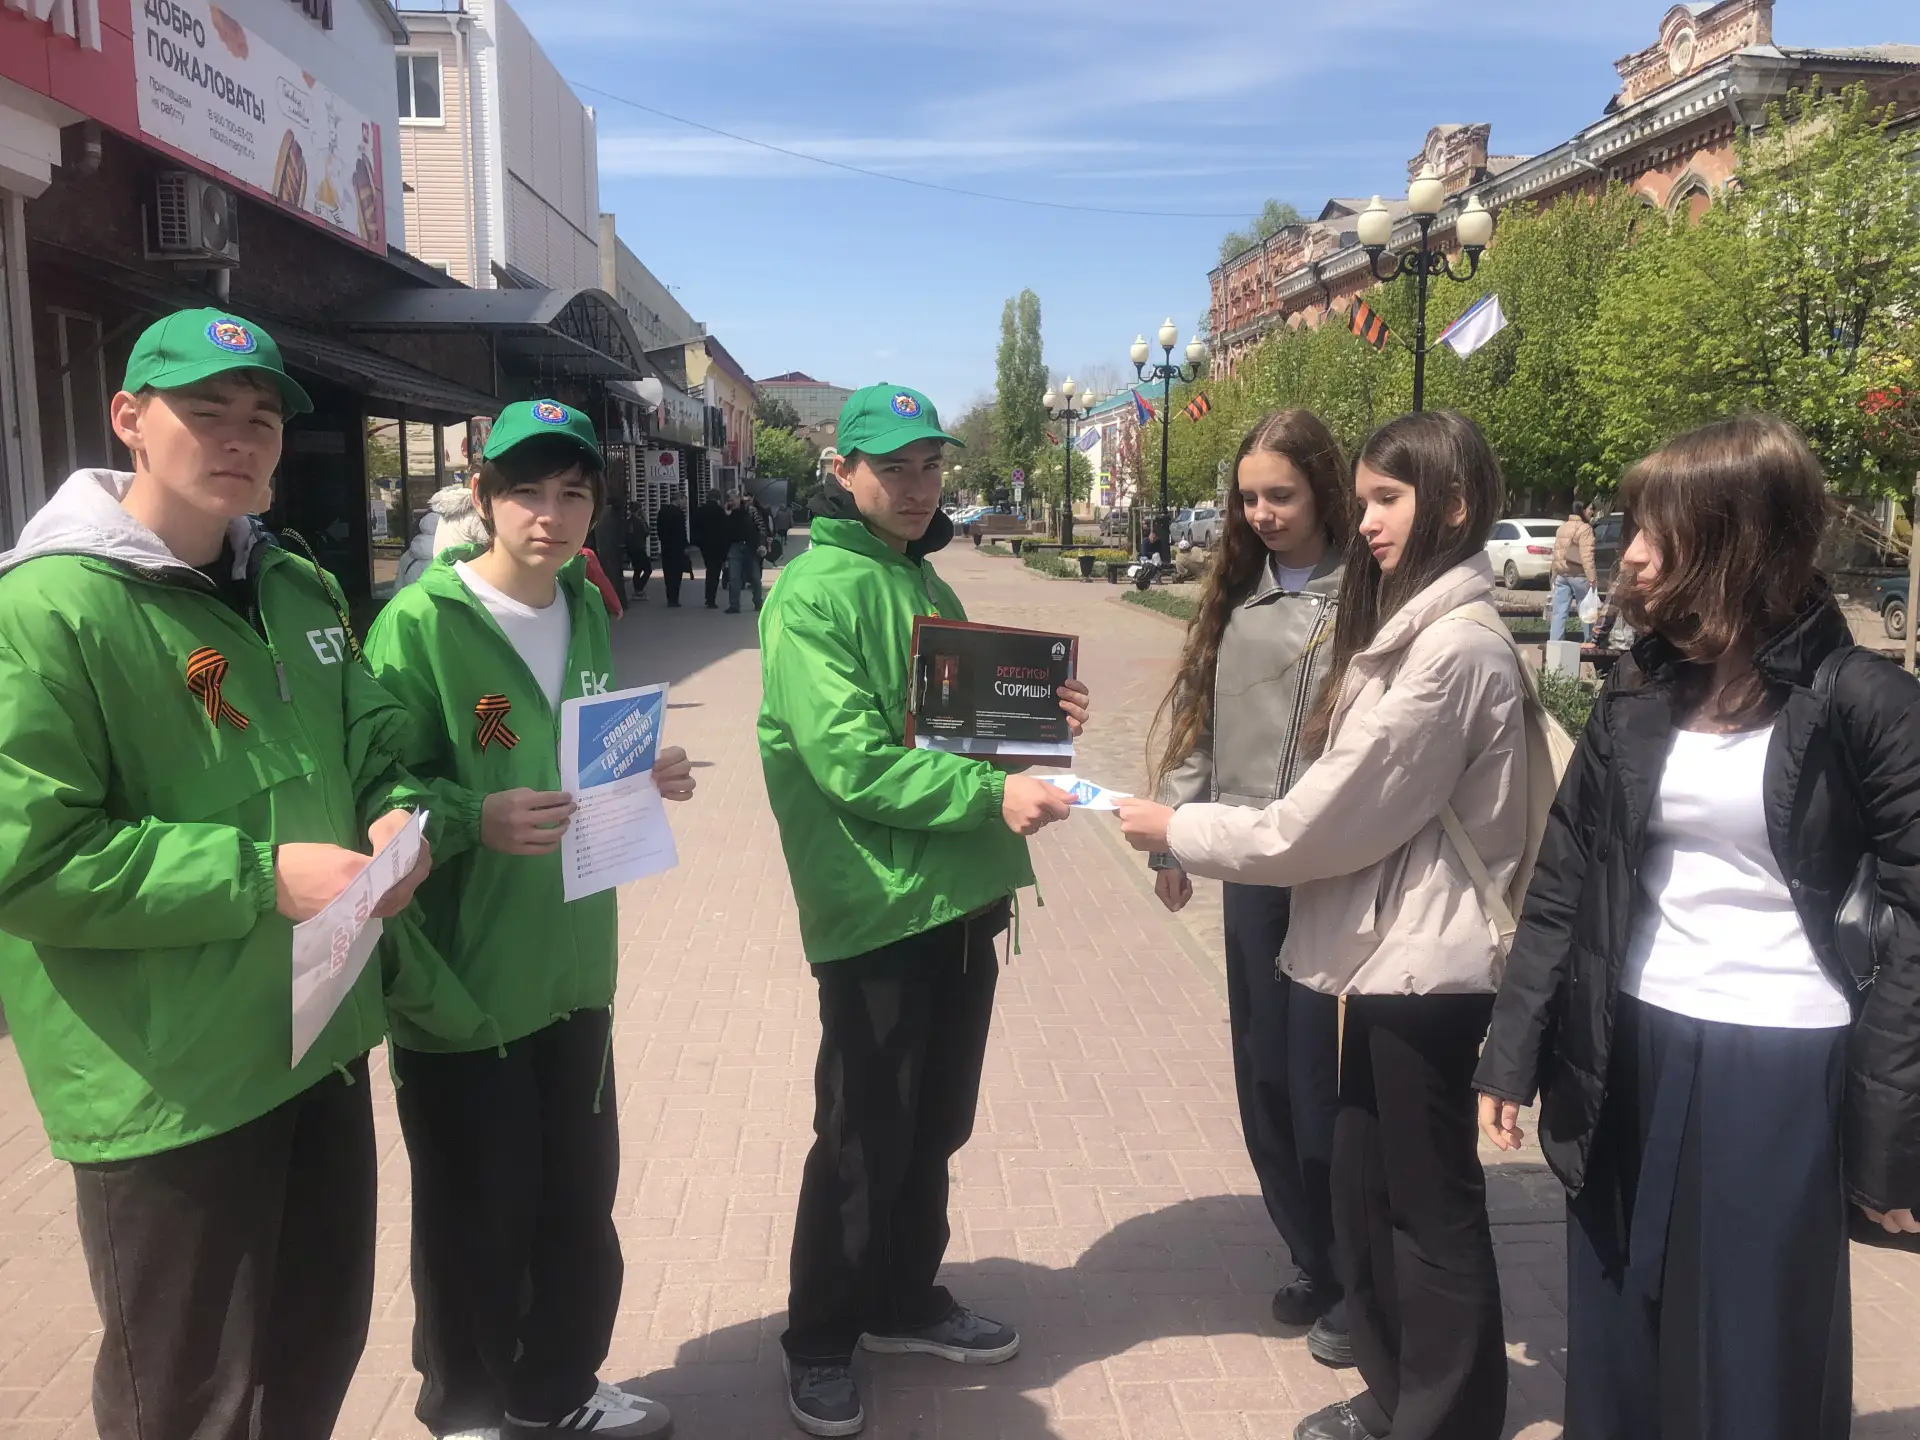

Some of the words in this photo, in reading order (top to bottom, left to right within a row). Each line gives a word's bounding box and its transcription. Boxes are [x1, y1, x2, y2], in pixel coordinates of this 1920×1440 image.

[144, 0, 205, 48] ДОБРО
[147, 28, 265, 125] ПОЖАЛОВАТЬ!
[996, 665, 1050, 680] БЕРЕГИСЬ!
[599, 748, 620, 771] ГДЕ
[617, 714, 653, 755] ТОРГУЮТ
[612, 732, 653, 779] СМЕРТЬЮ!
